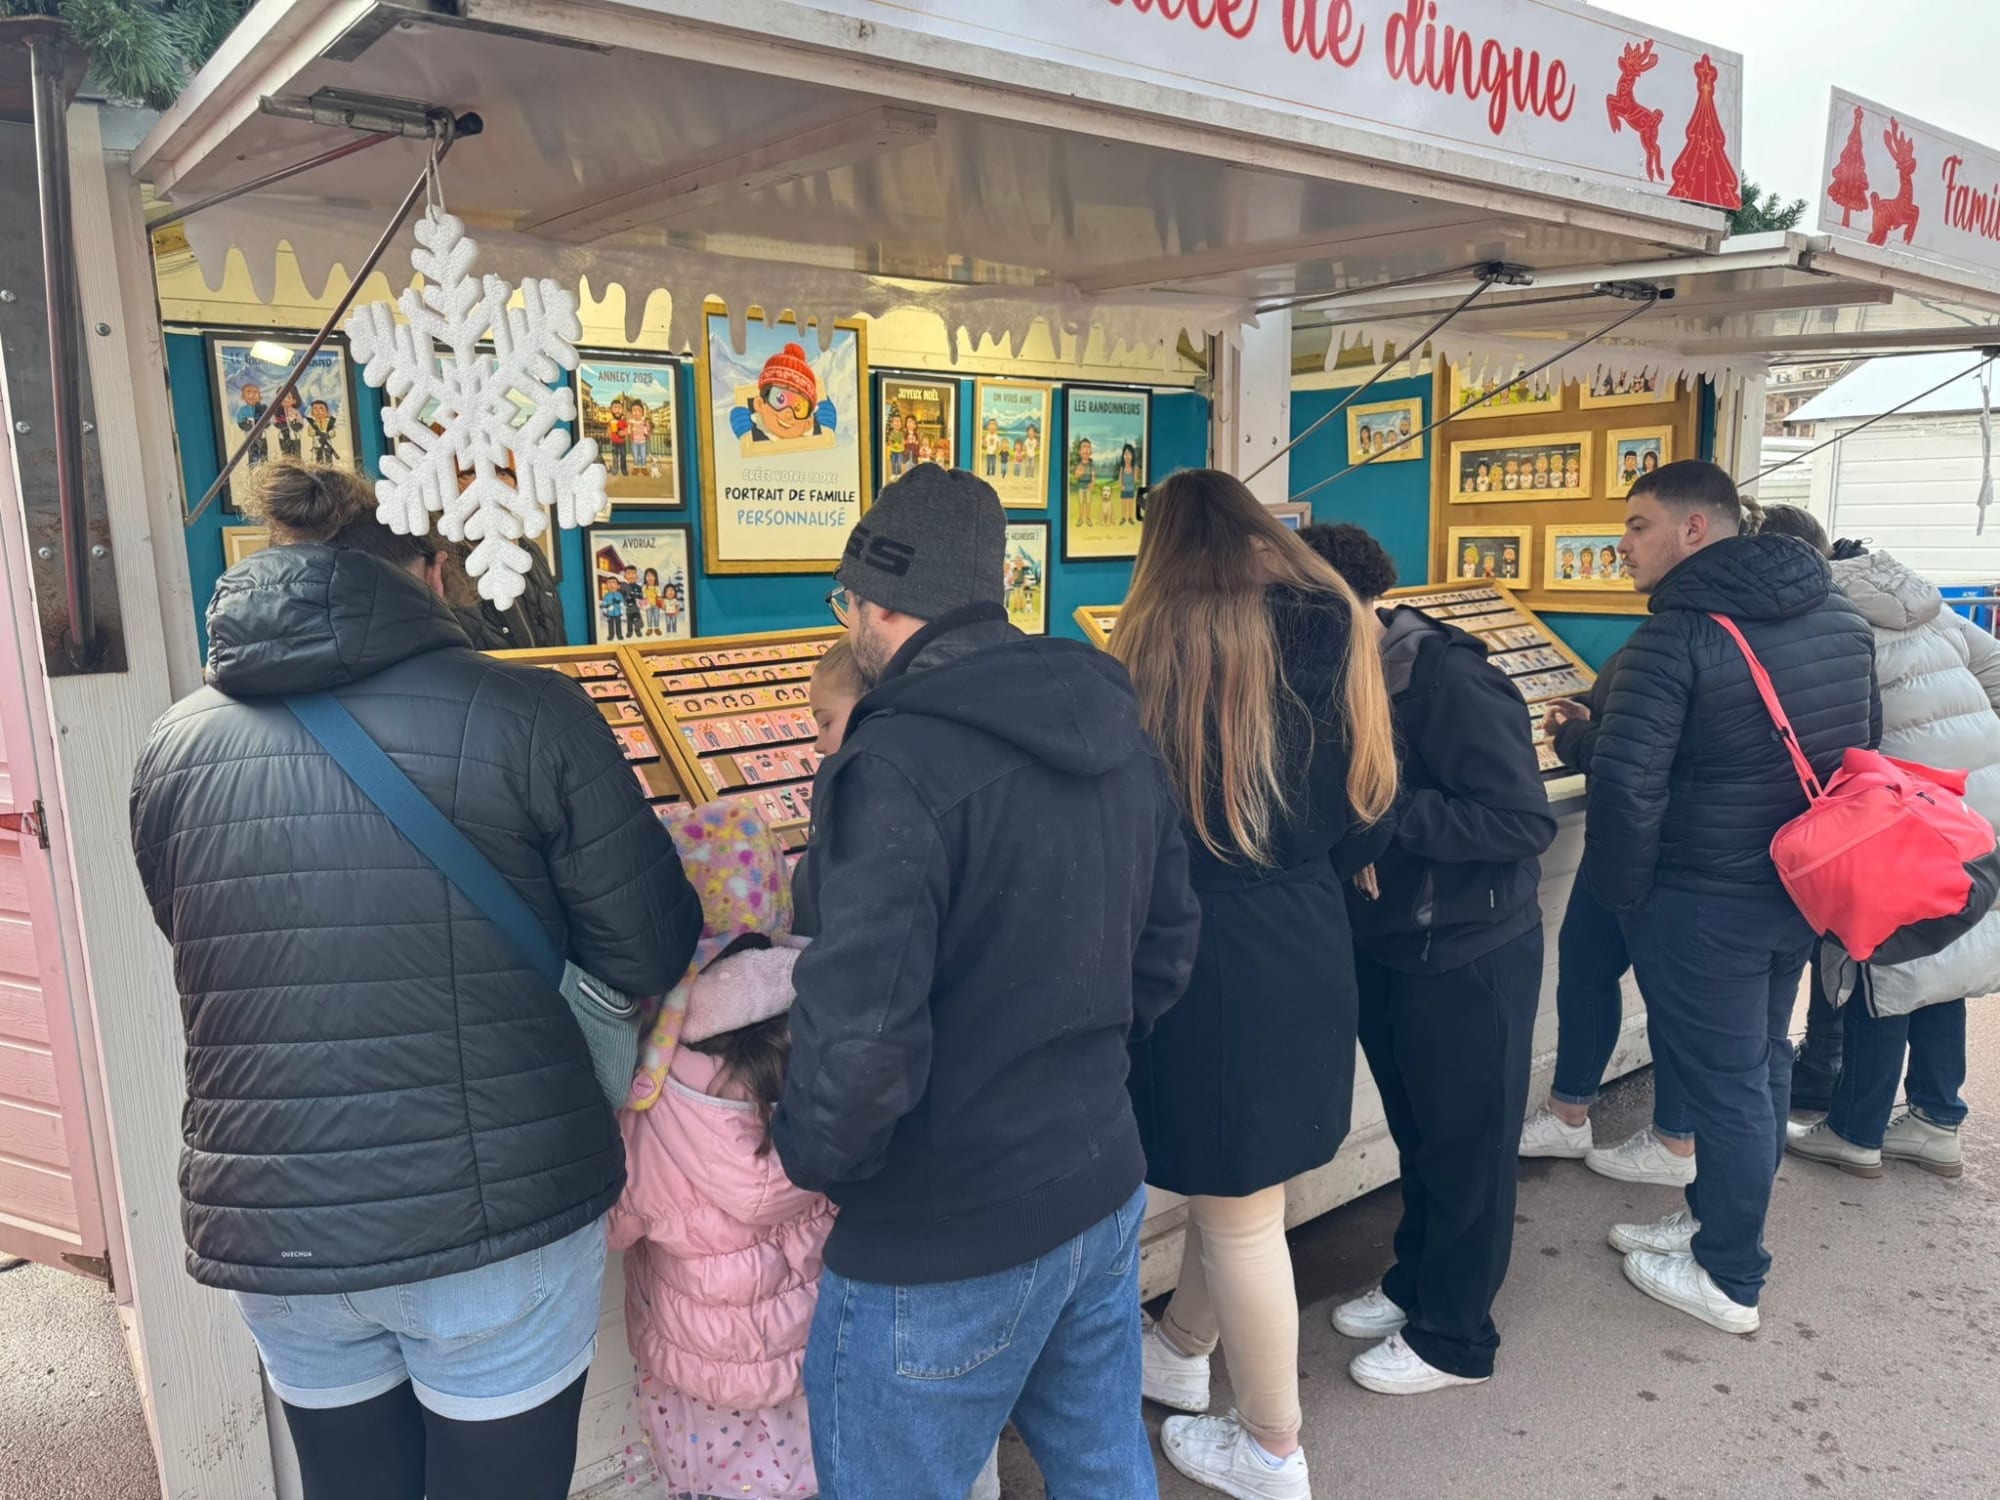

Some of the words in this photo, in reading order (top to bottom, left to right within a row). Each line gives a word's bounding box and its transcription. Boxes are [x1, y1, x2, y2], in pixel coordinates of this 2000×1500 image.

[1385, 0, 1576, 136] dingue
[598, 370, 631, 383] ANNECY
[633, 372, 654, 384] 2025
[897, 387, 922, 400] JOYEUX
[923, 388, 939, 401] NOËL
[993, 392, 1002, 402] ON
[1003, 392, 1018, 404] VOUS
[1074, 400, 1087, 412] LES
[1088, 401, 1141, 416] RANDONNEURS
[743, 466, 773, 482] CRÉEZ
[774, 470, 806, 483] VOTRE
[807, 471, 839, 485] CADRE
[724, 486, 784, 501] PORTRAIT
[788, 488, 806, 501] DE
[809, 489, 856, 503] FAMILLE
[737, 507, 846, 527] PERSONNALISÉ
[622, 536, 657, 549] AVORIAZ
[280, 1250, 313, 1258] QUECHUA
